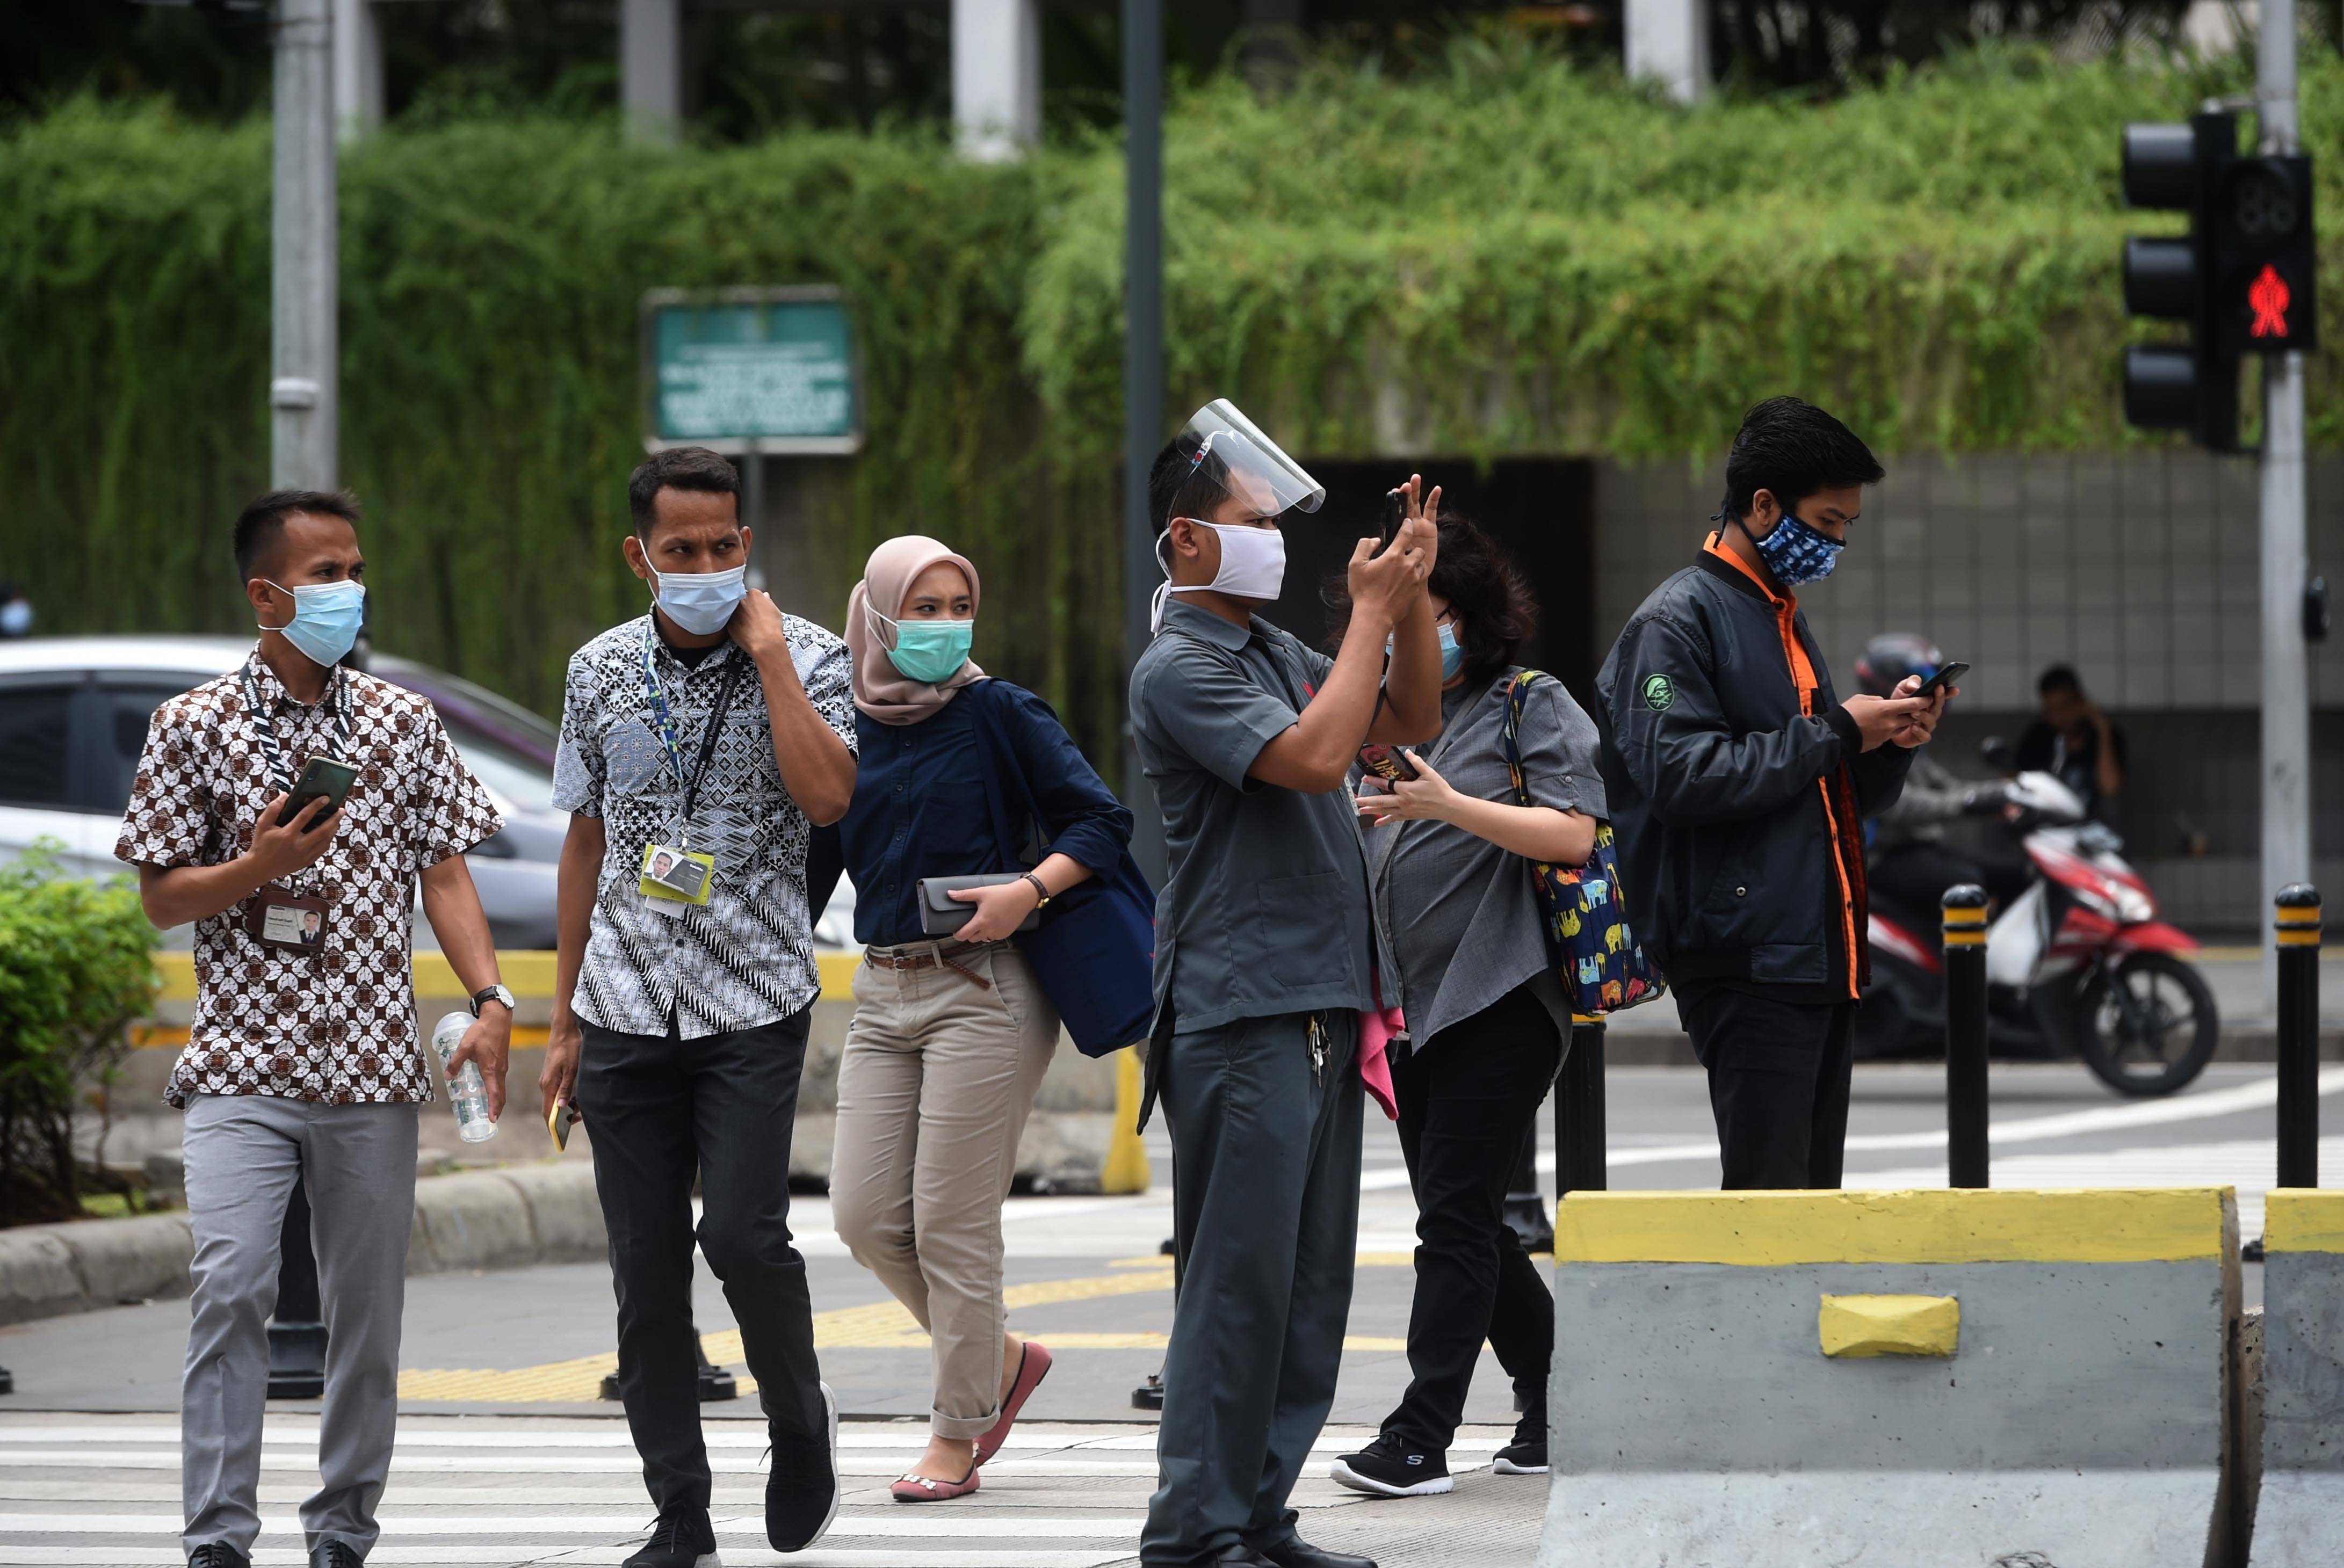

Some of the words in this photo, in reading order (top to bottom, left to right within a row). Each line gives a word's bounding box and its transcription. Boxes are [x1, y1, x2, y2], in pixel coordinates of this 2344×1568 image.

[709, 715, 720, 736] Partners
[717, 687, 730, 714] Conference
[726, 673, 735, 687] 2017
